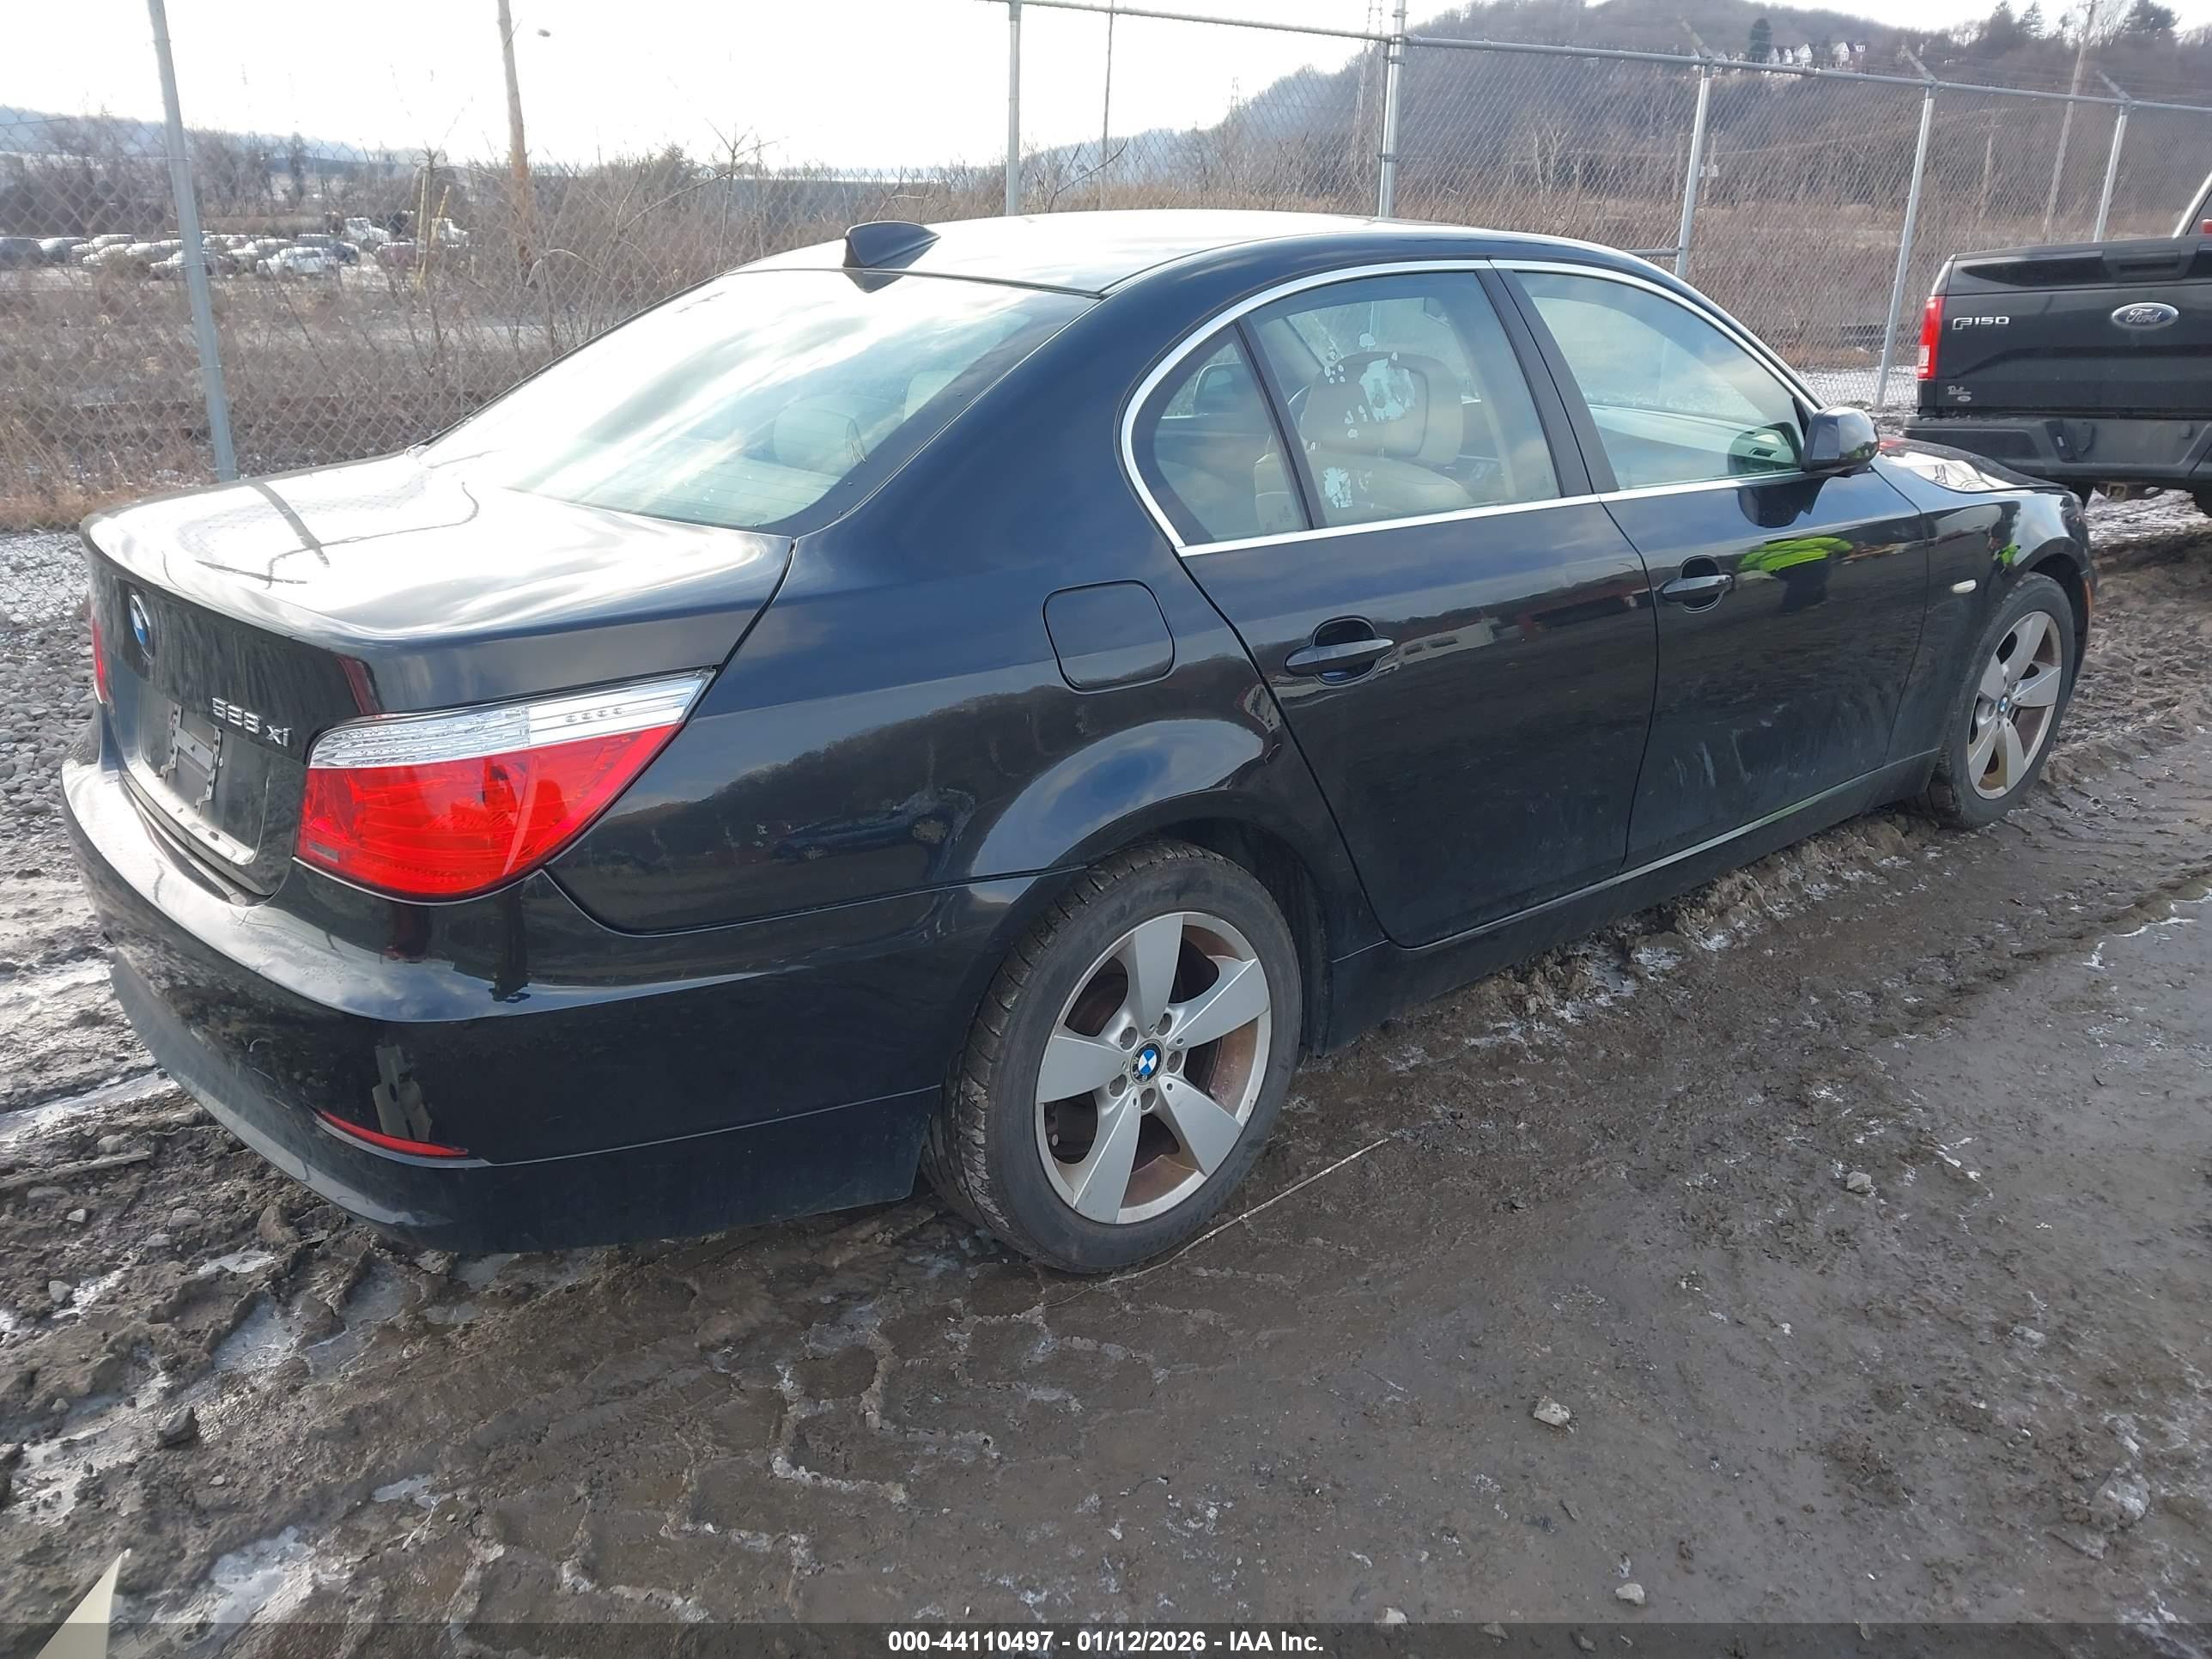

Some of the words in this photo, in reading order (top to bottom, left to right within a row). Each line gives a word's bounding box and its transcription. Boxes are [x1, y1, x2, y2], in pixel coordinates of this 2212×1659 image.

[1953, 316, 2010, 331] F150
[2125, 307, 2163, 325] Ford
[212, 697, 262, 735] 528
[265, 724, 292, 747] xi
